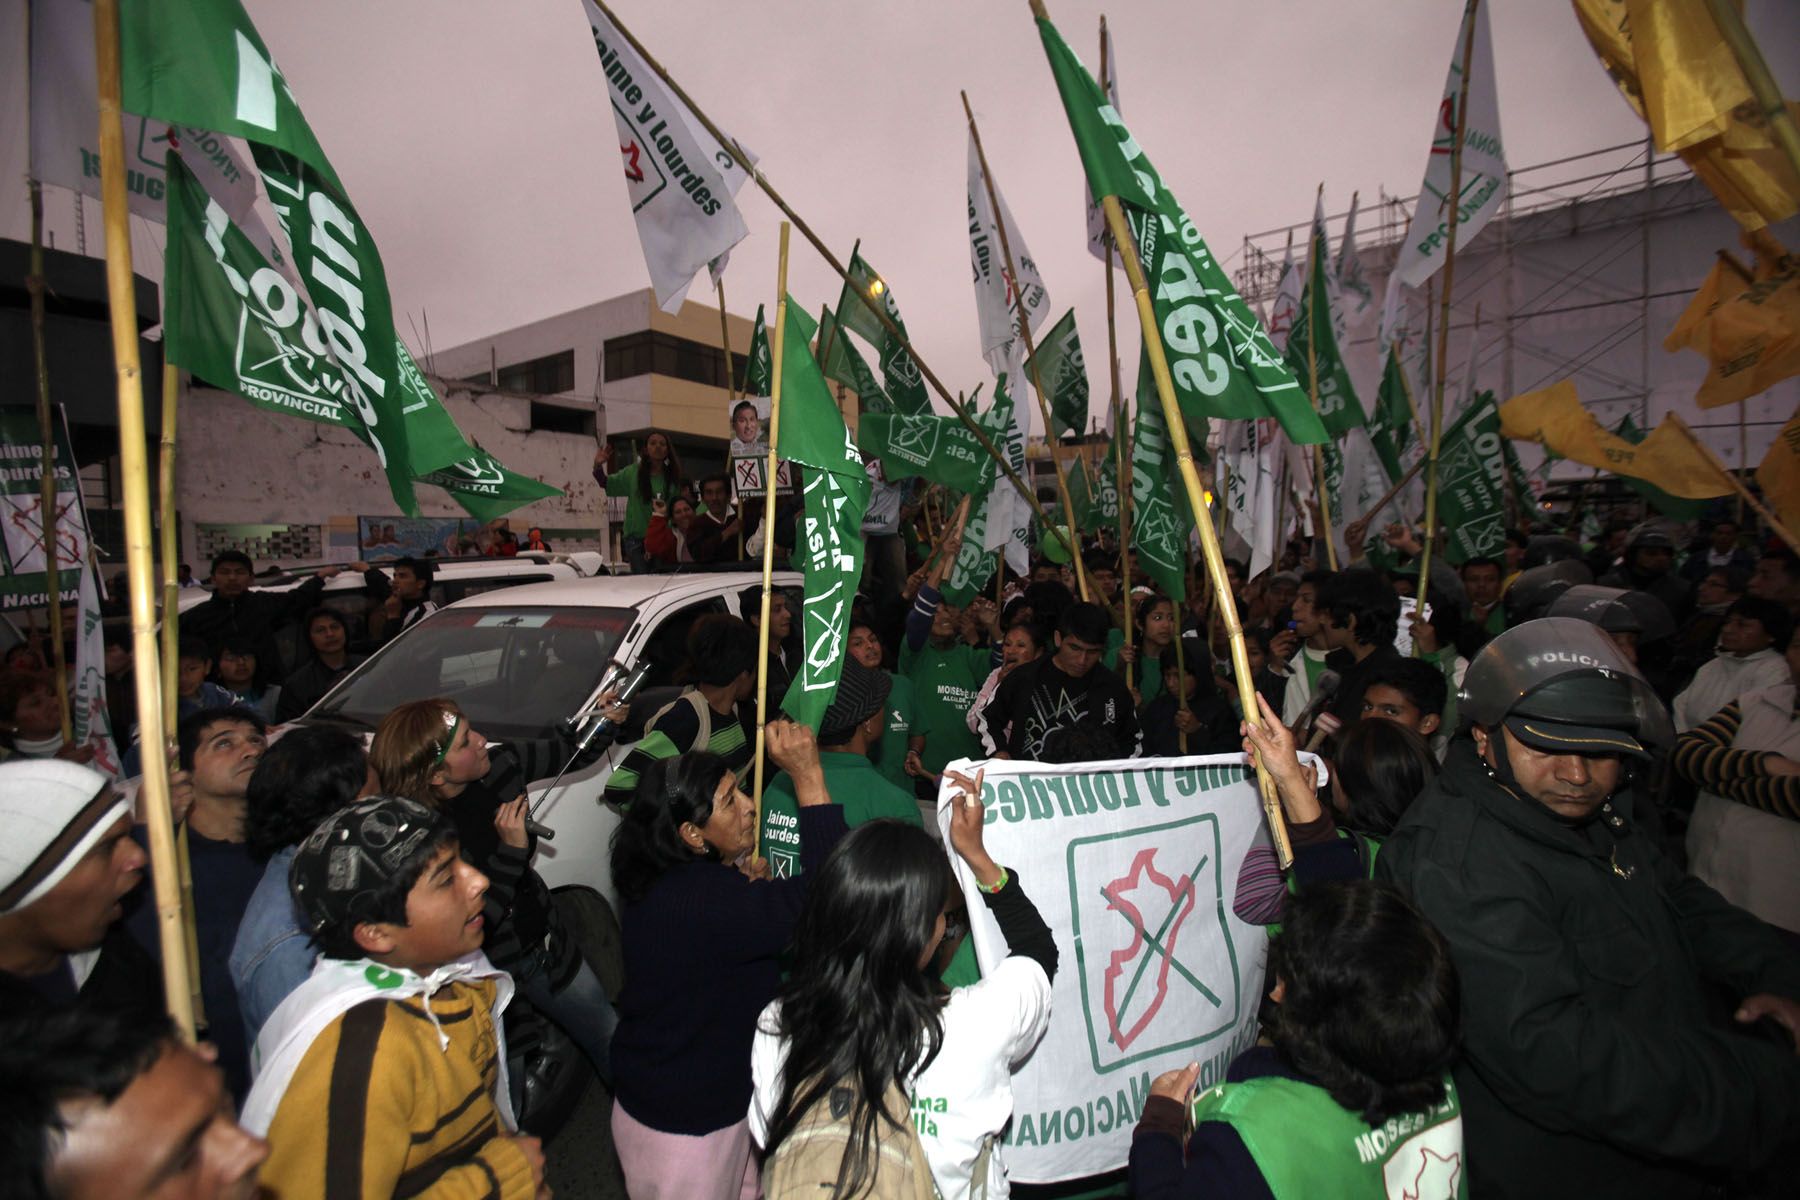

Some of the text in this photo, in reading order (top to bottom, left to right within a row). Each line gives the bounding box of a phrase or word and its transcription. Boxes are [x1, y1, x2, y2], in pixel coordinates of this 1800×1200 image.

[592, 26, 722, 216] aime y Lourdes
[239, 382, 343, 421] PROVINCIAL
[1471, 475, 1494, 511] VOTA
[804, 517, 826, 572] ASI:
[764, 827, 800, 845] ourdes
[766, 809, 798, 828] Jaime
